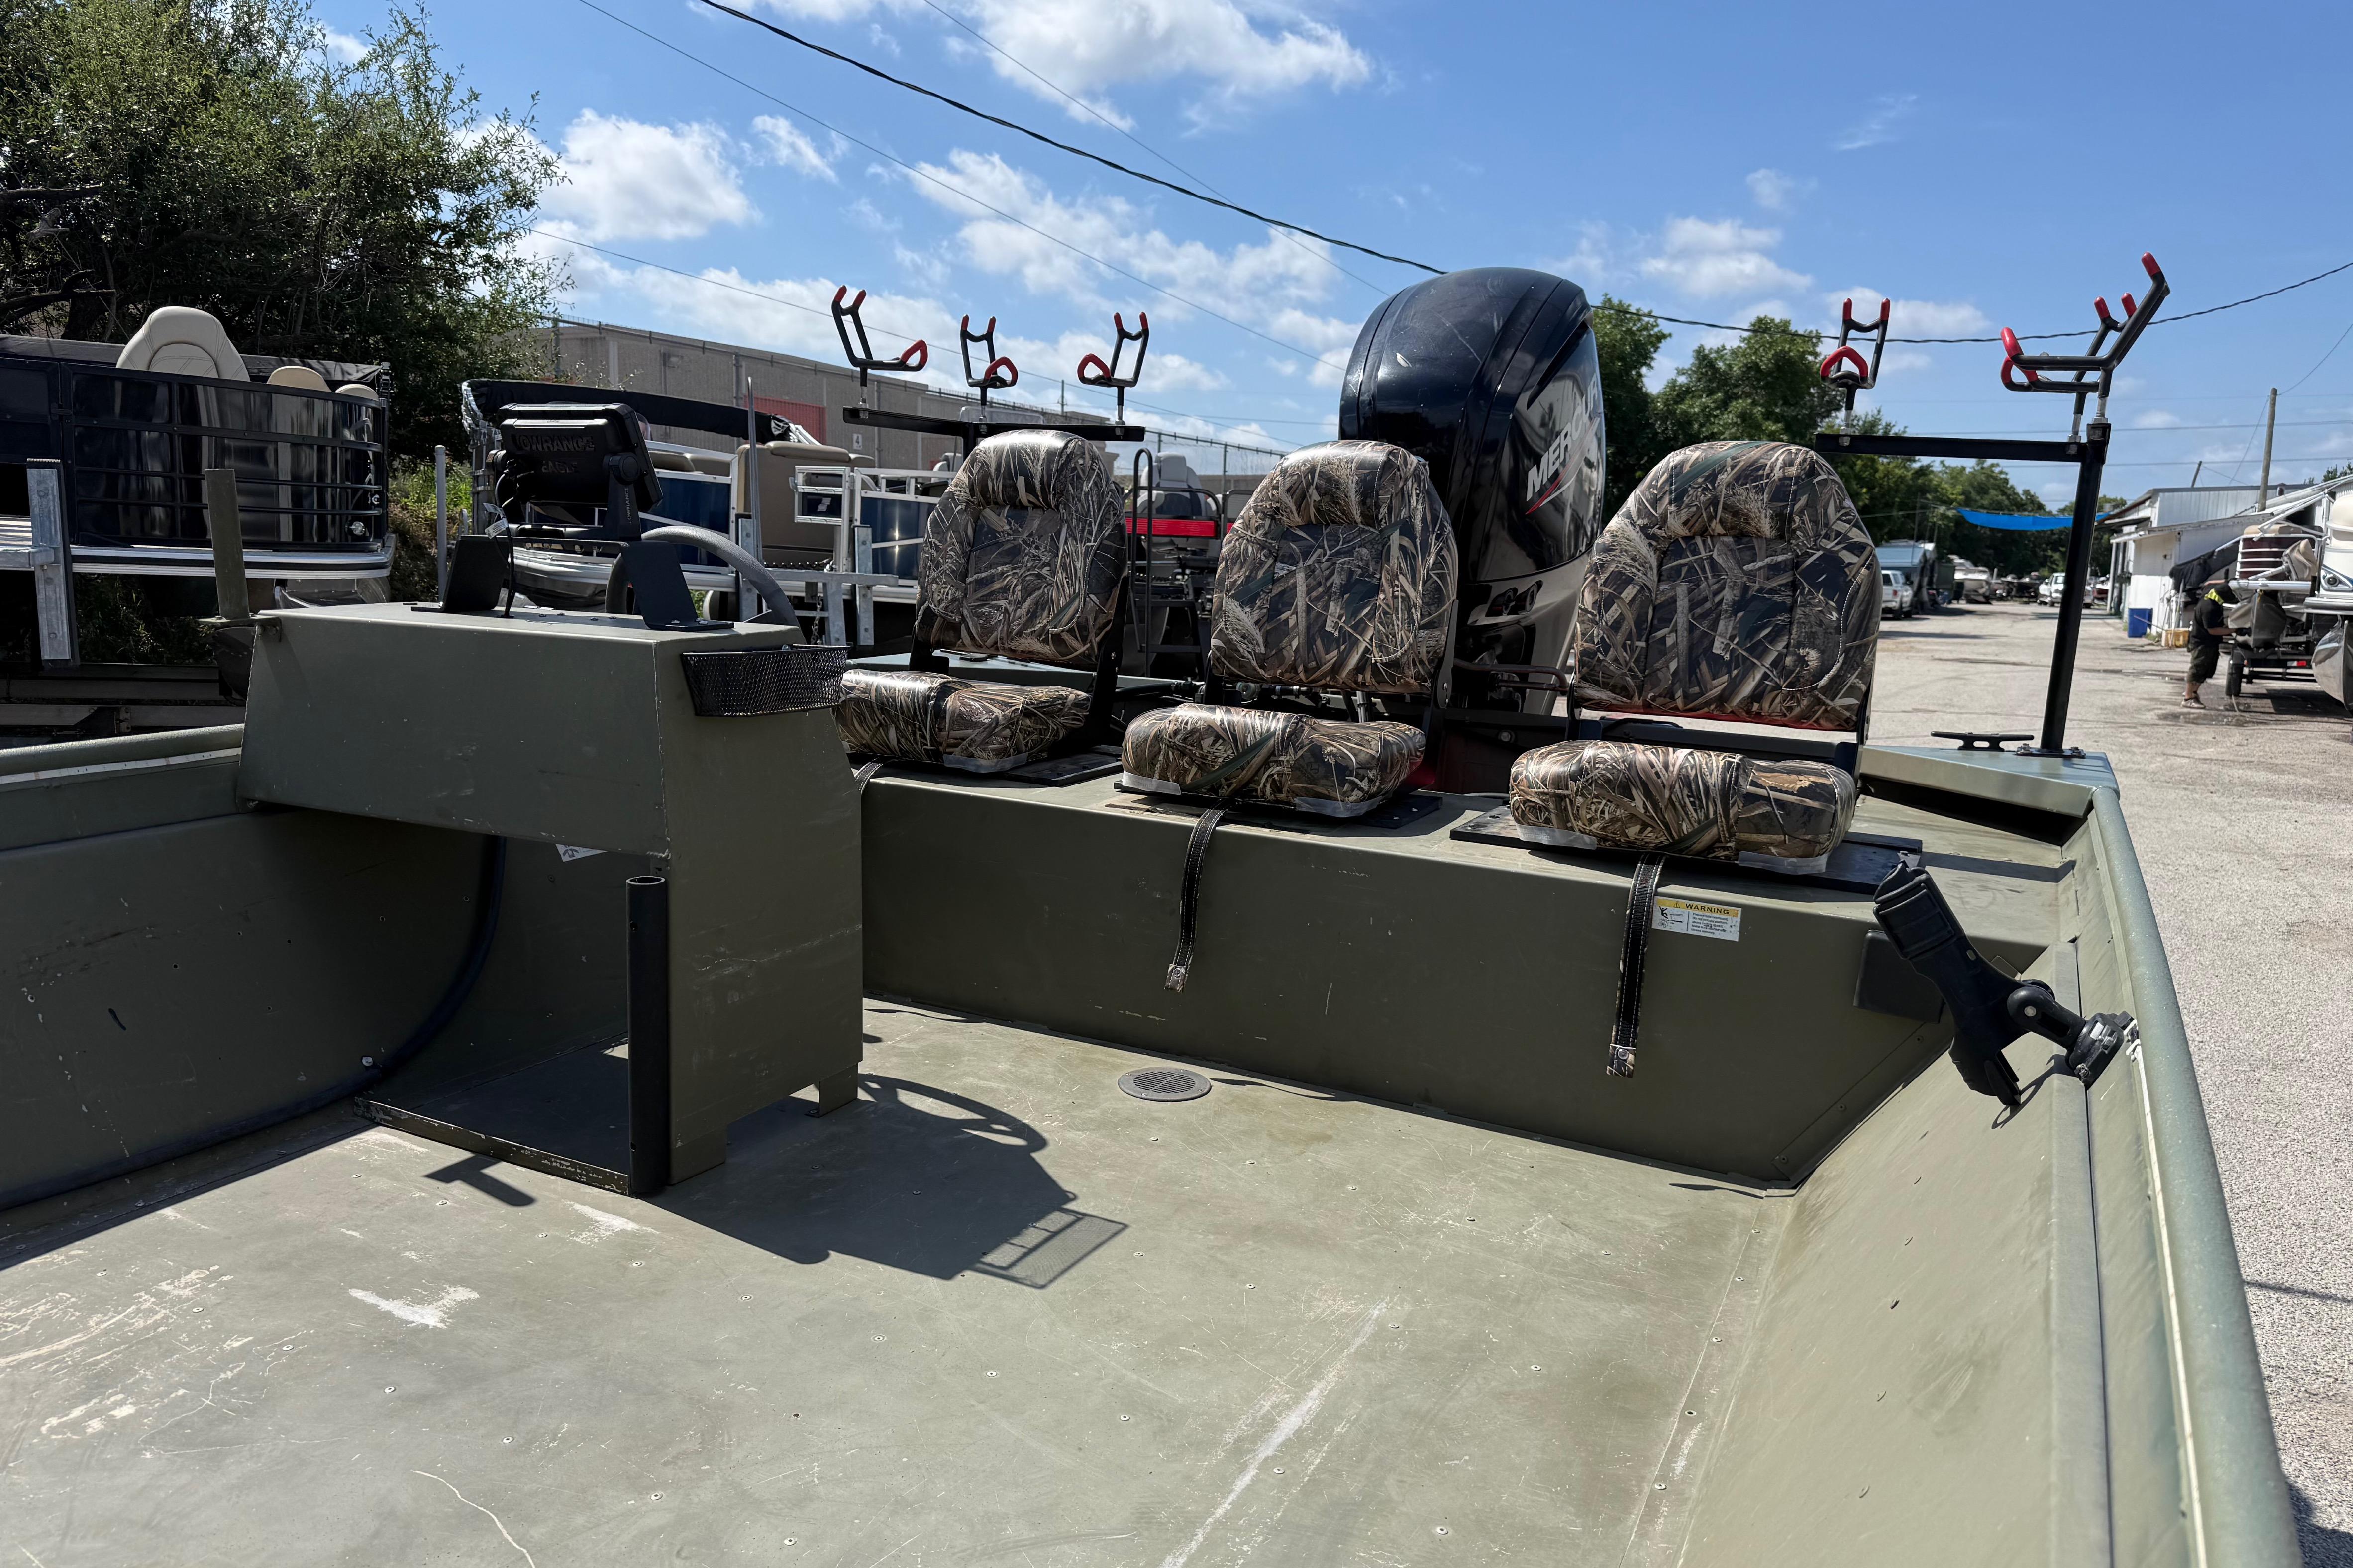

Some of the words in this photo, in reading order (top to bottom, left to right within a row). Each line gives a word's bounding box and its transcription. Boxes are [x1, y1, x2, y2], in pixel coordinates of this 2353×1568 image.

[512, 434, 596, 452] LOWRANCE
[1526, 372, 1598, 501] MERCUR
[1685, 903, 1729, 915] WARNING
